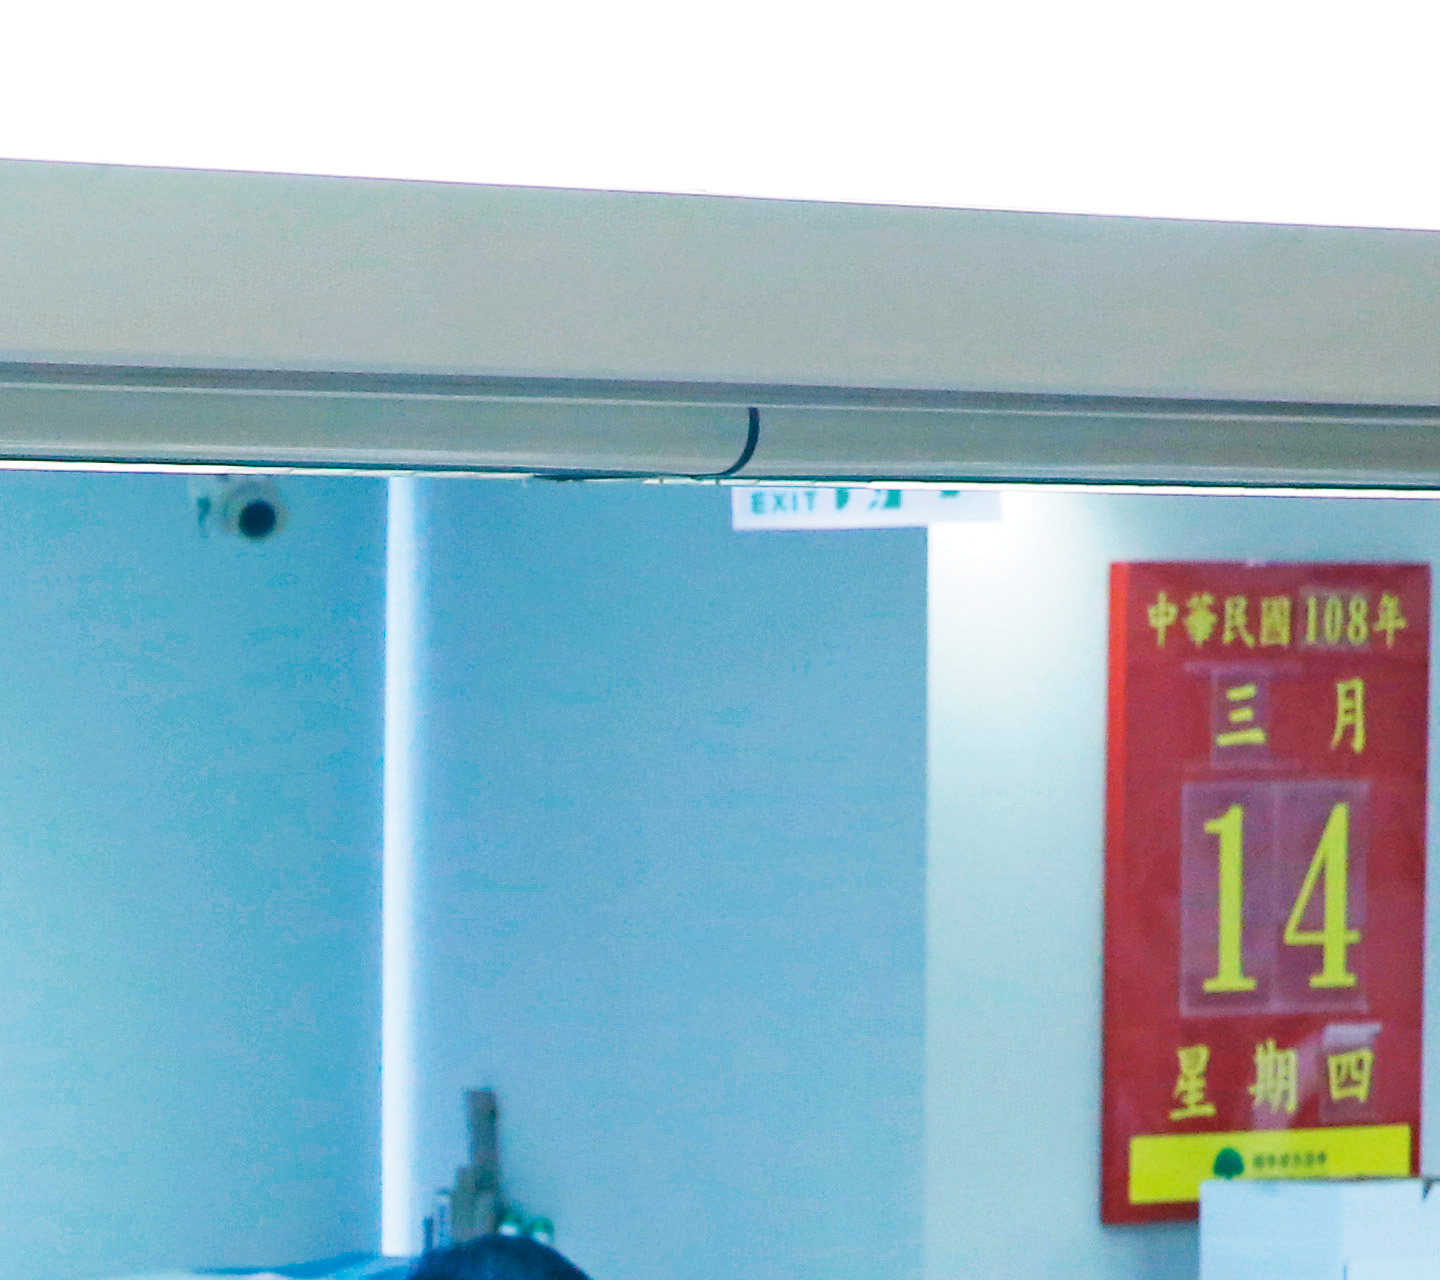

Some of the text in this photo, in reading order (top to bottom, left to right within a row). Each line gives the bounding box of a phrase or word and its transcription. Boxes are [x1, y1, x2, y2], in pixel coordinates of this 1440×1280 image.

[751, 489, 817, 515] EXIT
[1203, 803, 1361, 993] 14
[1169, 1039, 1374, 1122] 星期四
